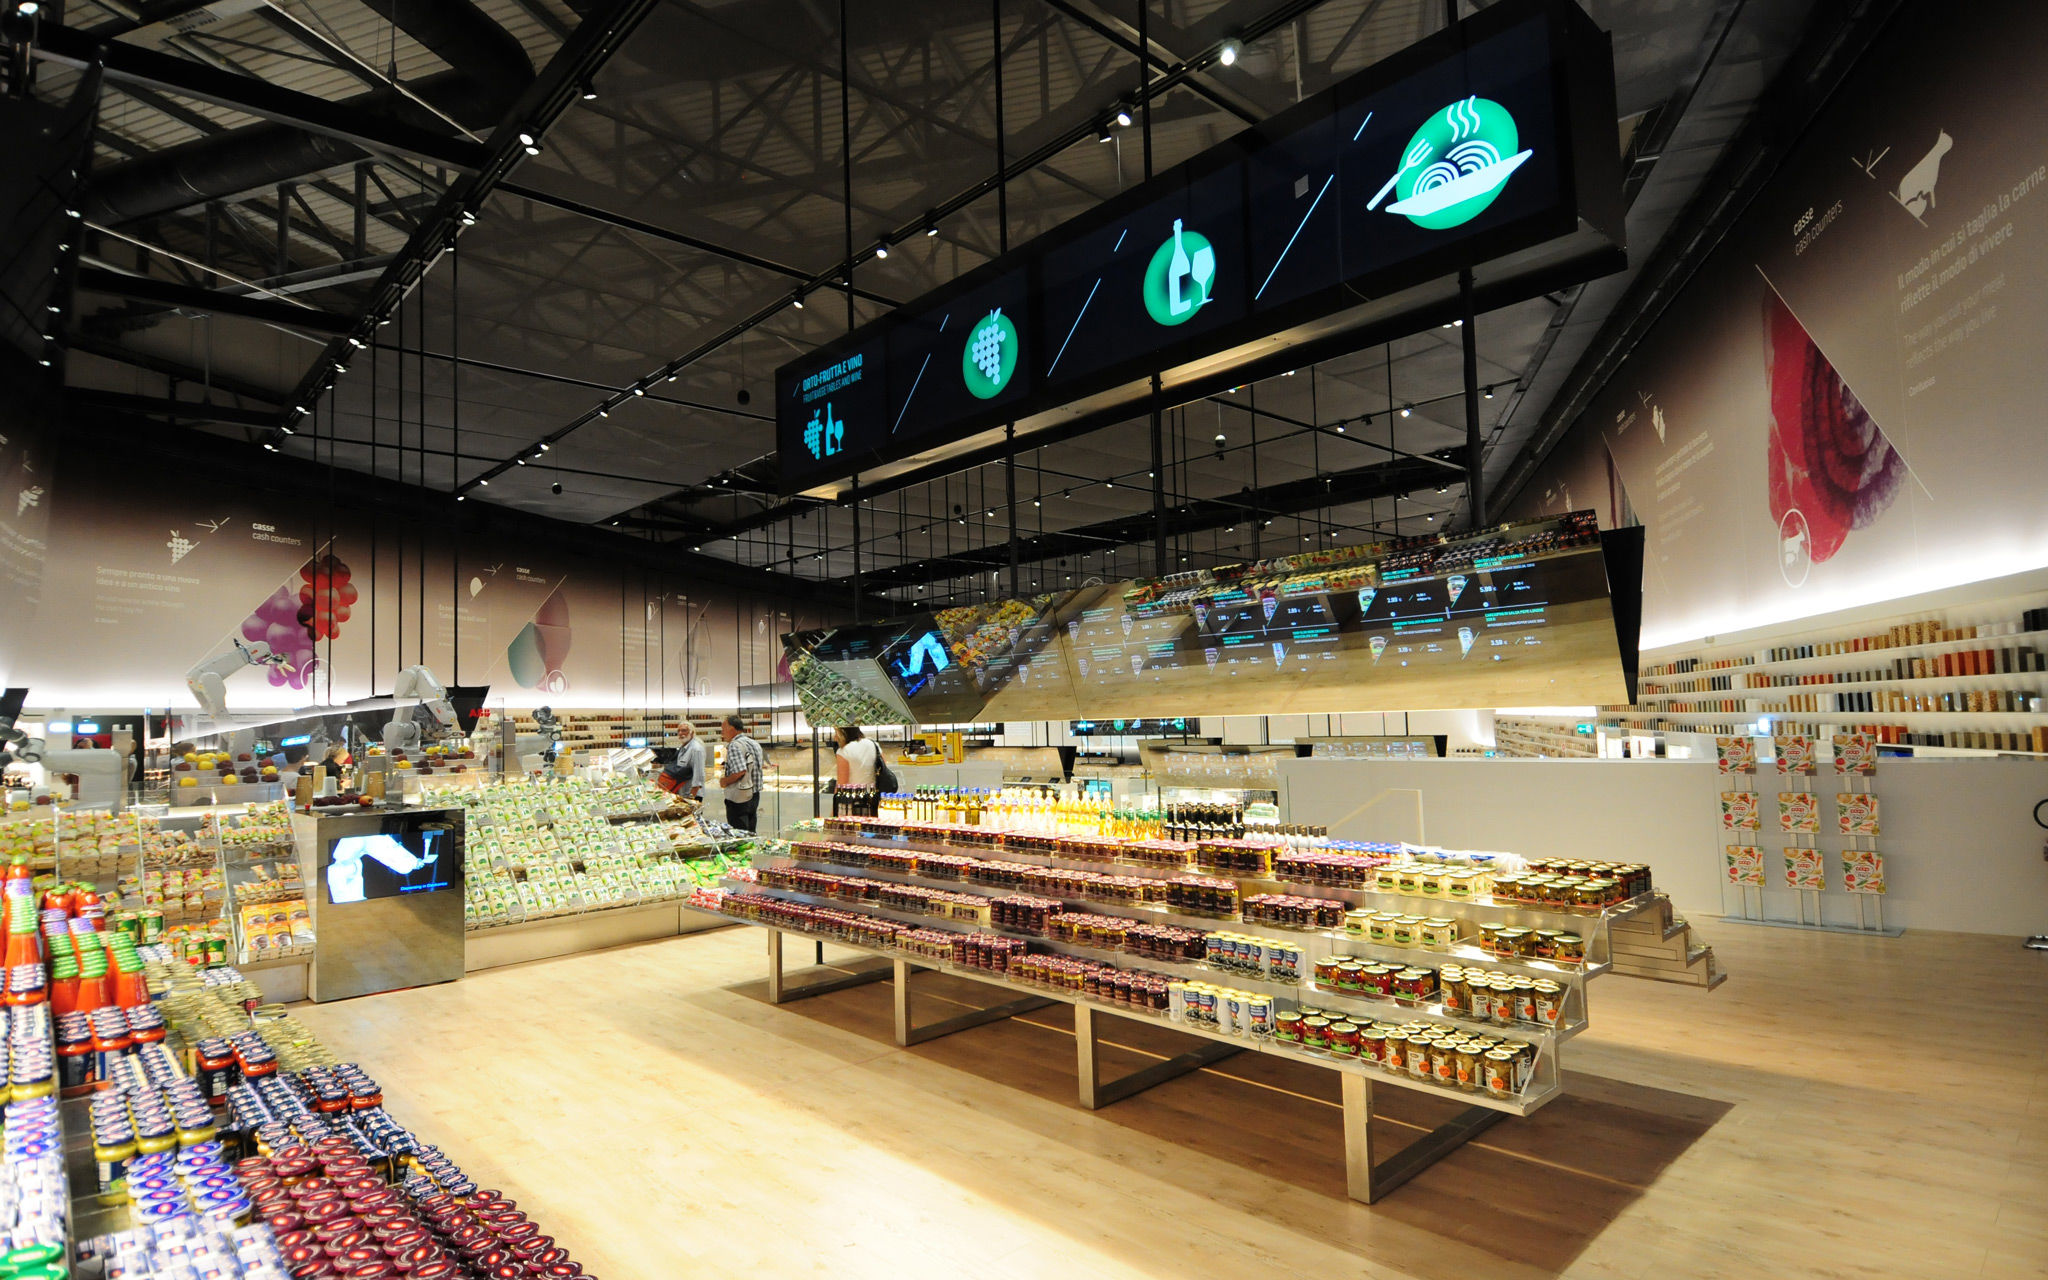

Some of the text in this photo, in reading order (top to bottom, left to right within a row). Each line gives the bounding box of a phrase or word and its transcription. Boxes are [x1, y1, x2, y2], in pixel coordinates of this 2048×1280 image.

[1794, 207, 1814, 236] casse
[1796, 199, 1843, 256] cash counters
[1905, 256, 1930, 285] modo
[1930, 248, 1940, 265] in
[1941, 233, 1956, 258] cui
[1957, 226, 1966, 244] si
[1966, 203, 1998, 237] taglia
[1998, 193, 2011, 213] la
[2012, 164, 2047, 202] carne
[1940, 256, 1967, 286] modo
[1968, 244, 1979, 266] di
[1978, 221, 2014, 256] vivere
[803, 353, 863, 391] ORTO-FRUTTA E VINO
[842, 374, 851, 387] AND
[252, 522, 276, 532] casse
[252, 532, 302, 546] cash counters
[469, 708, 491, 718] ABB
